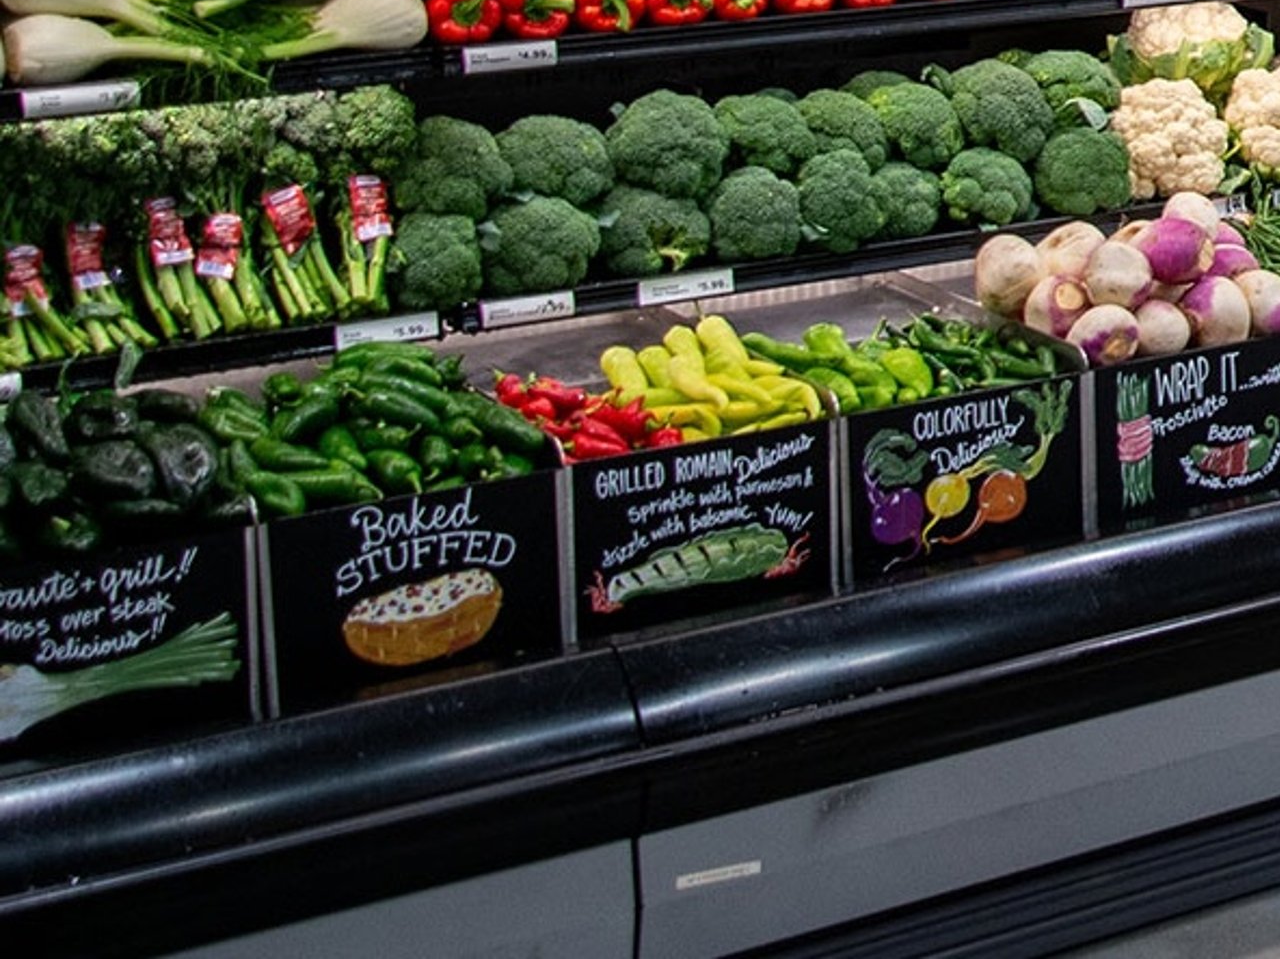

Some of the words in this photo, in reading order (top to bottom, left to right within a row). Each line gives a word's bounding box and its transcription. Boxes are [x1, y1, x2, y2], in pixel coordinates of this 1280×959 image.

[1154, 355, 1210, 407] WRAP
[912, 394, 1011, 442] COLORFULLY
[1208, 423, 1256, 442] Bacon
[595, 461, 665, 499] GRILLED
[675, 449, 733, 484] ROMAIN
[732, 433, 816, 484] Delicious
[930, 415, 1026, 475] Delicious
[699, 481, 733, 506] with
[734, 472, 802, 504] parmesan
[351, 487, 479, 552] Baked
[650, 516, 686, 542] with
[334, 531, 518, 598] STUFFED
[61, 606, 106, 632] over
[110, 591, 176, 623] steak
